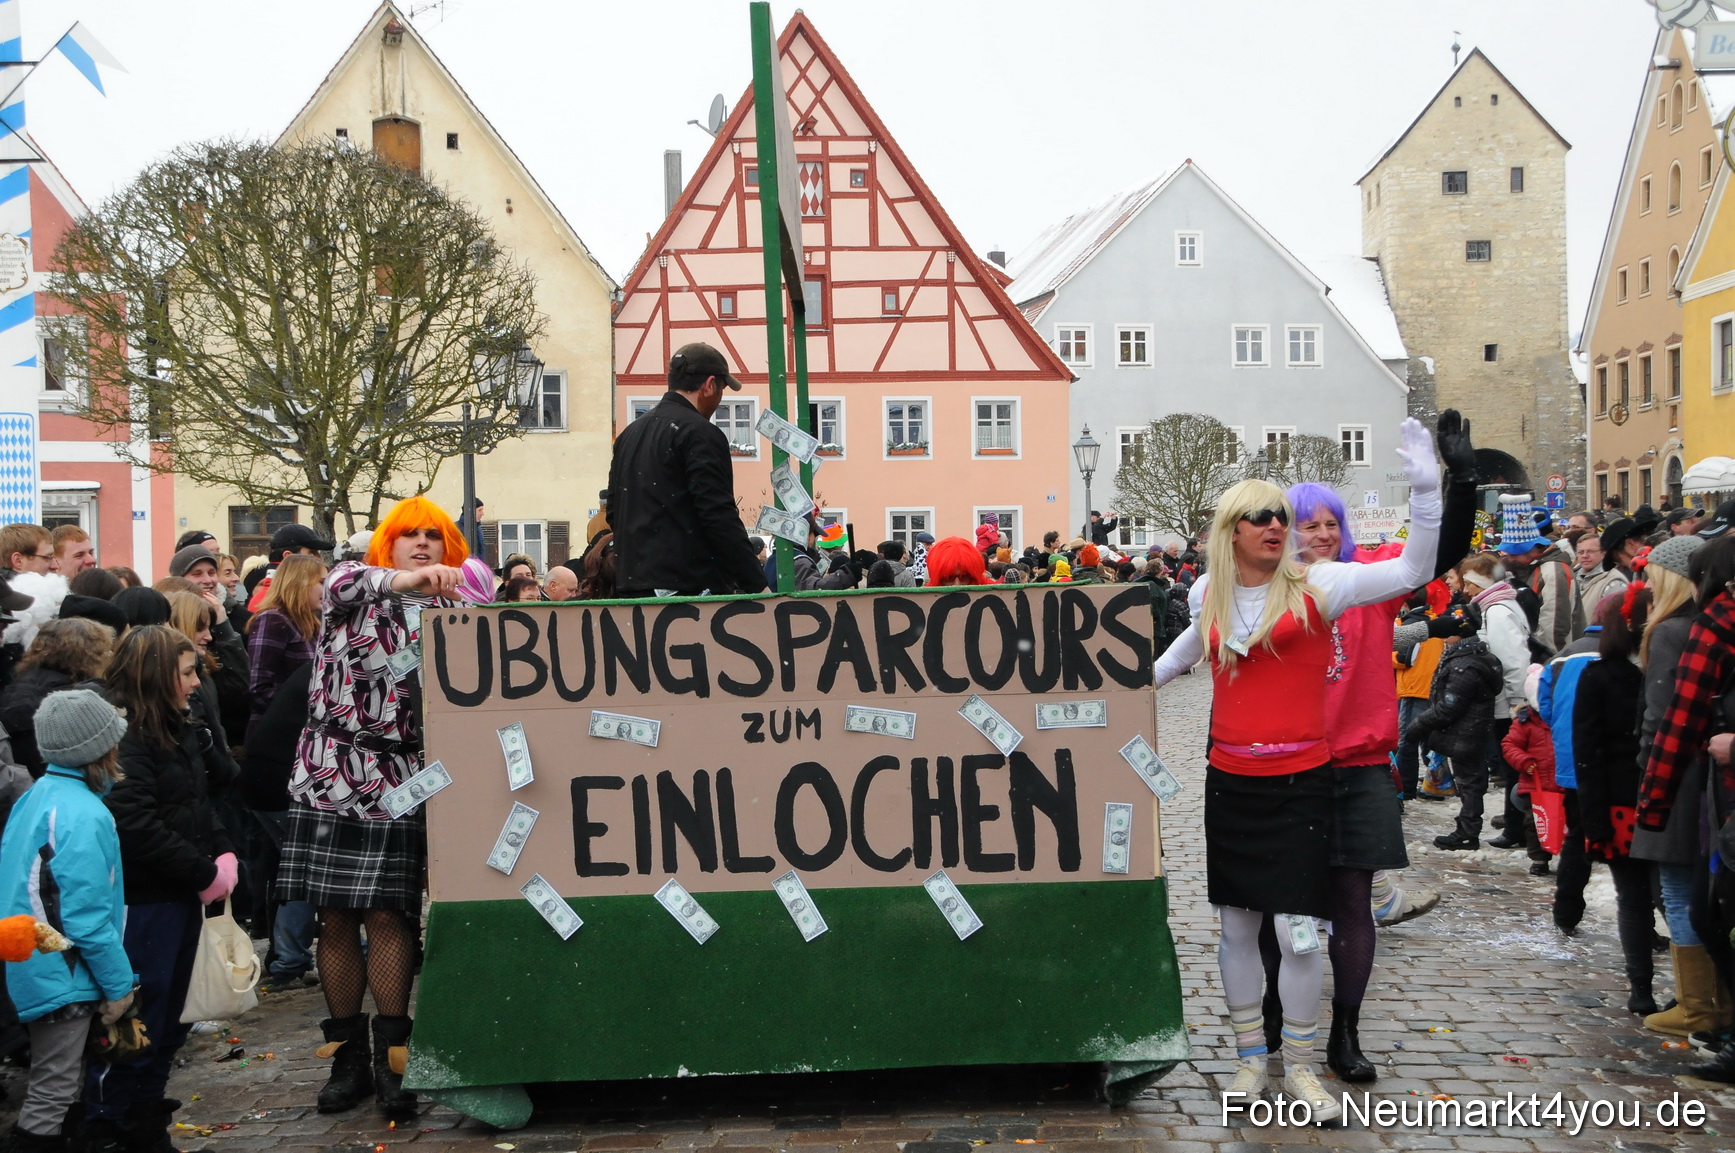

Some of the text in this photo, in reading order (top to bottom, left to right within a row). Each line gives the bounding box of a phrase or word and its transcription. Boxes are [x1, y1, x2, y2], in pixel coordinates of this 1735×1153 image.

[1708, 34, 1735, 55] Be
[1367, 495, 1377, 504] 15
[1364, 520, 1395, 529] BERCHING
[432, 586, 1153, 707] ÜBUNGSPARCOURS
[741, 706, 822, 743] ZUM
[570, 748, 1082, 877] EINLOCHEN
